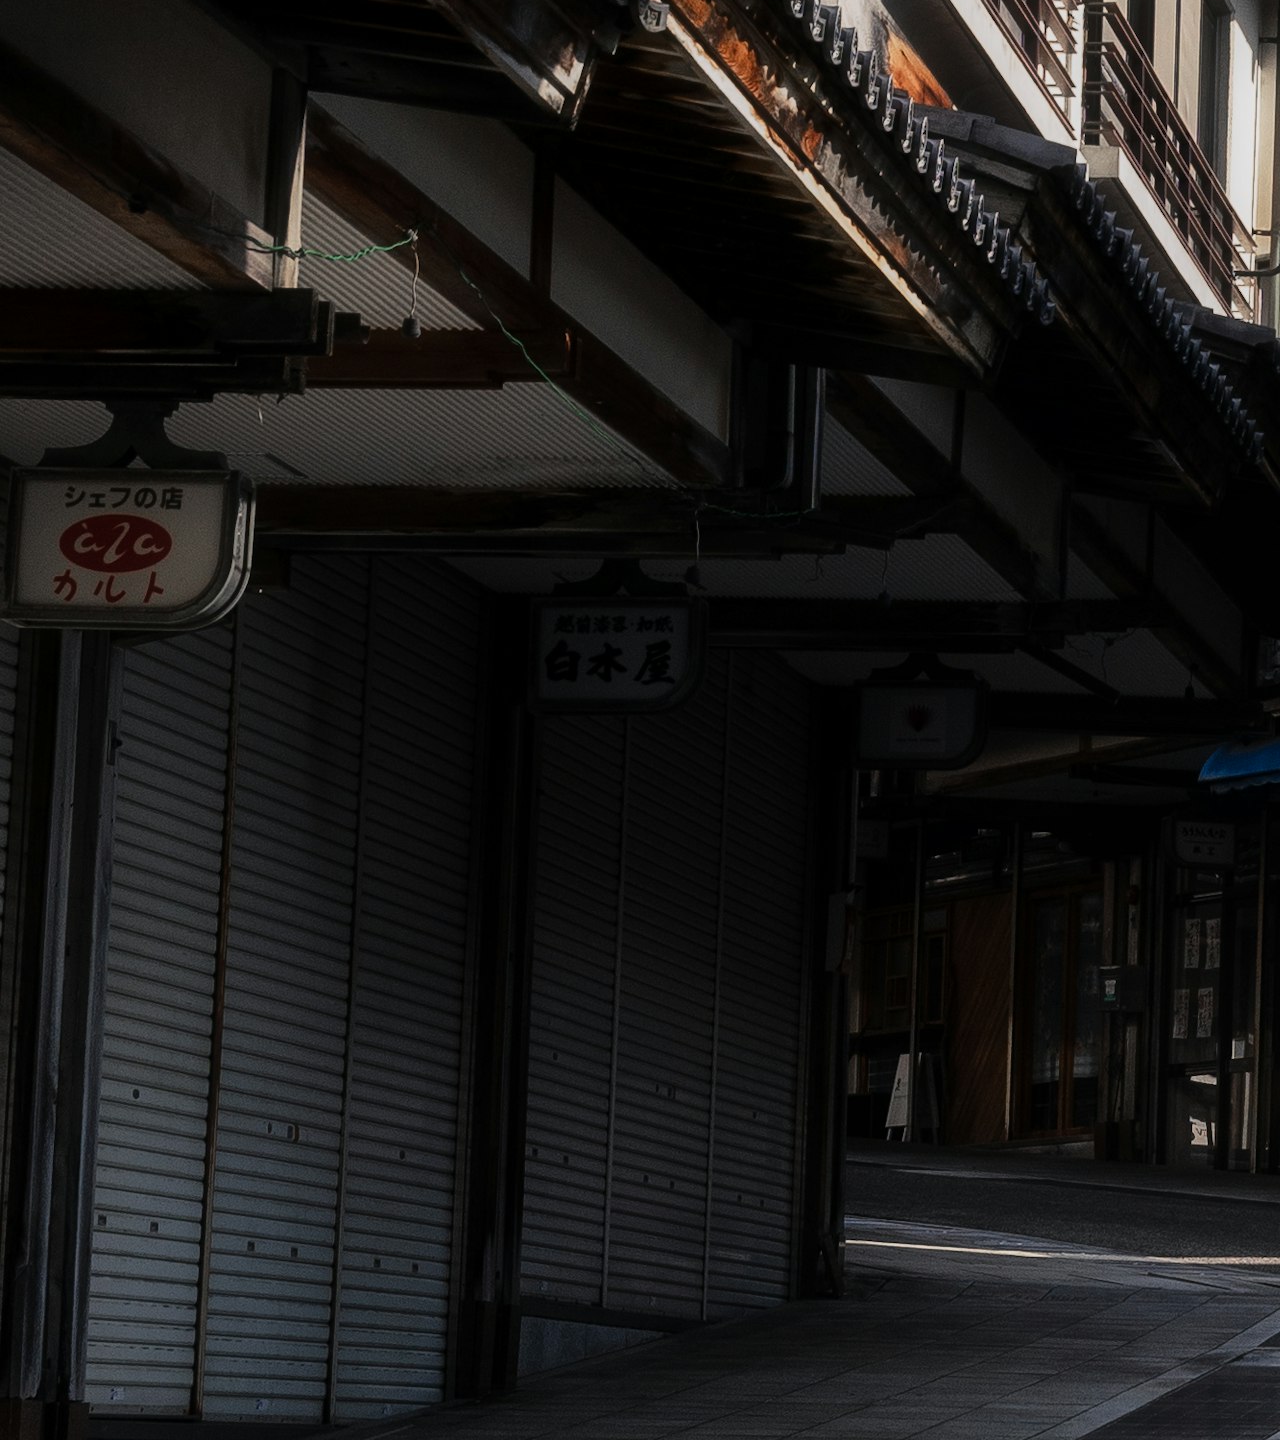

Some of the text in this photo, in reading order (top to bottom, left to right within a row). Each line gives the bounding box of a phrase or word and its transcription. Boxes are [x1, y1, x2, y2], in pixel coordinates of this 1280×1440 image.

[64, 486, 184, 510] シェフの店
[53, 569, 164, 603] カルト
[544, 639, 676, 685] 白木屋
